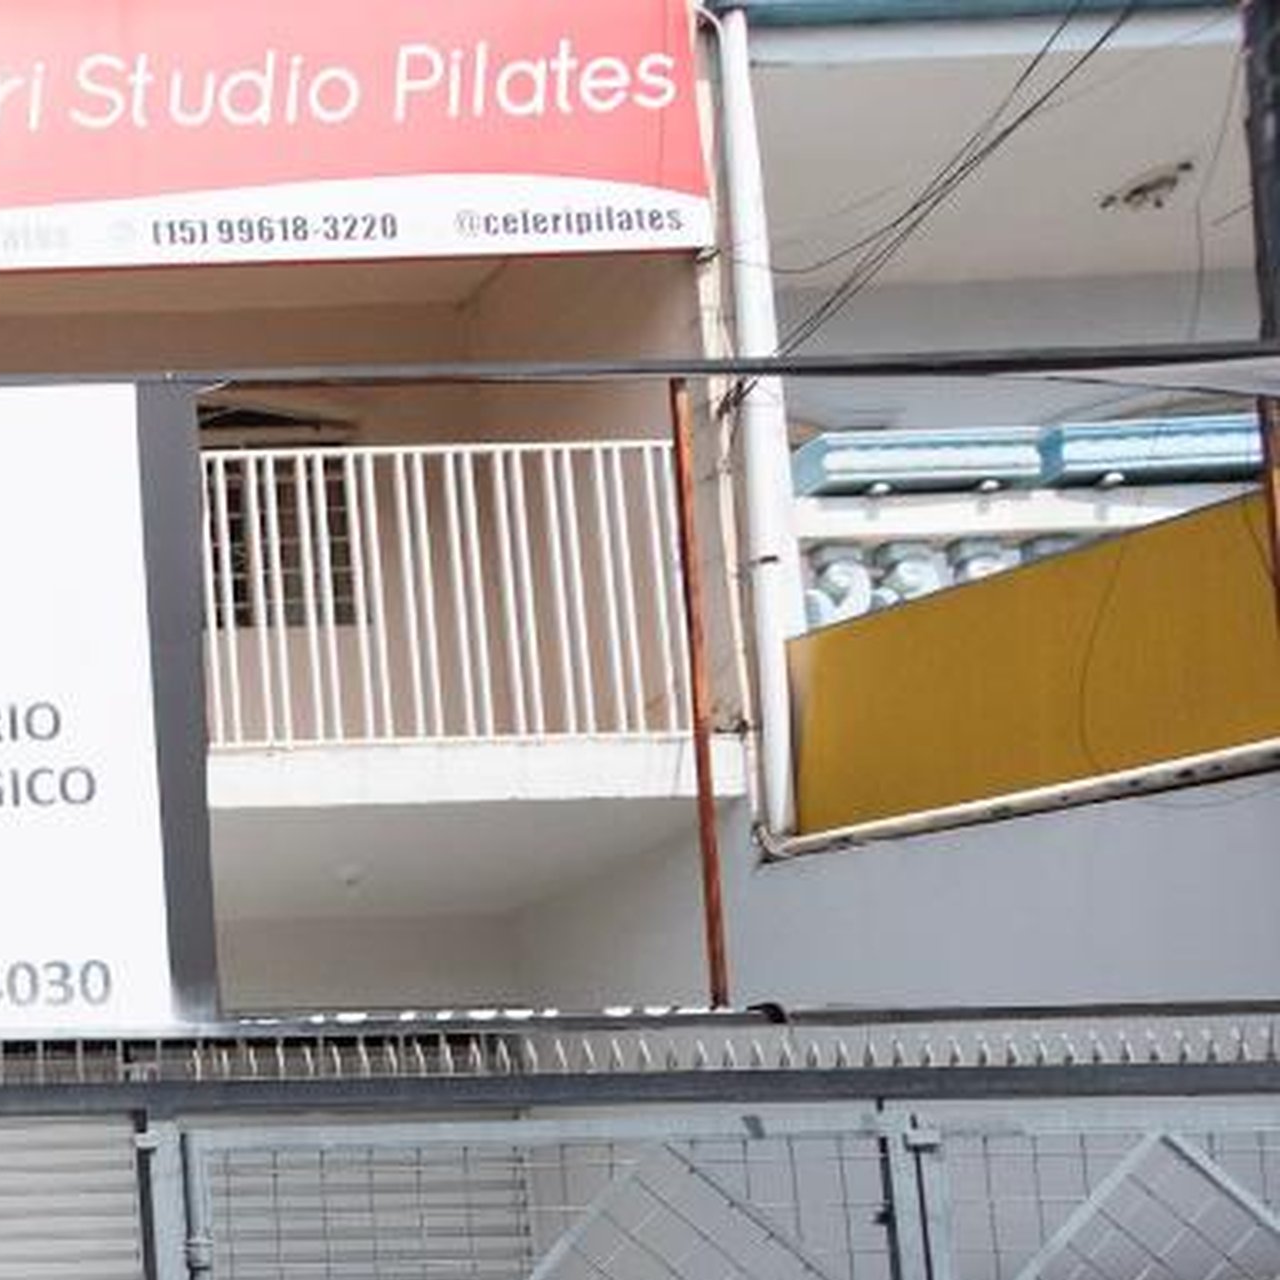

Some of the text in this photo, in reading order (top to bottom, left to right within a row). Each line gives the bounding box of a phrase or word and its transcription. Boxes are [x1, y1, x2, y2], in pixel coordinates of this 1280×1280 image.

[68, 49, 362, 129] Studio
[394, 38, 678, 121] Pilates
[216, 212, 399, 244] 99618-3220
[454, 205, 684, 239] @celeripilates
